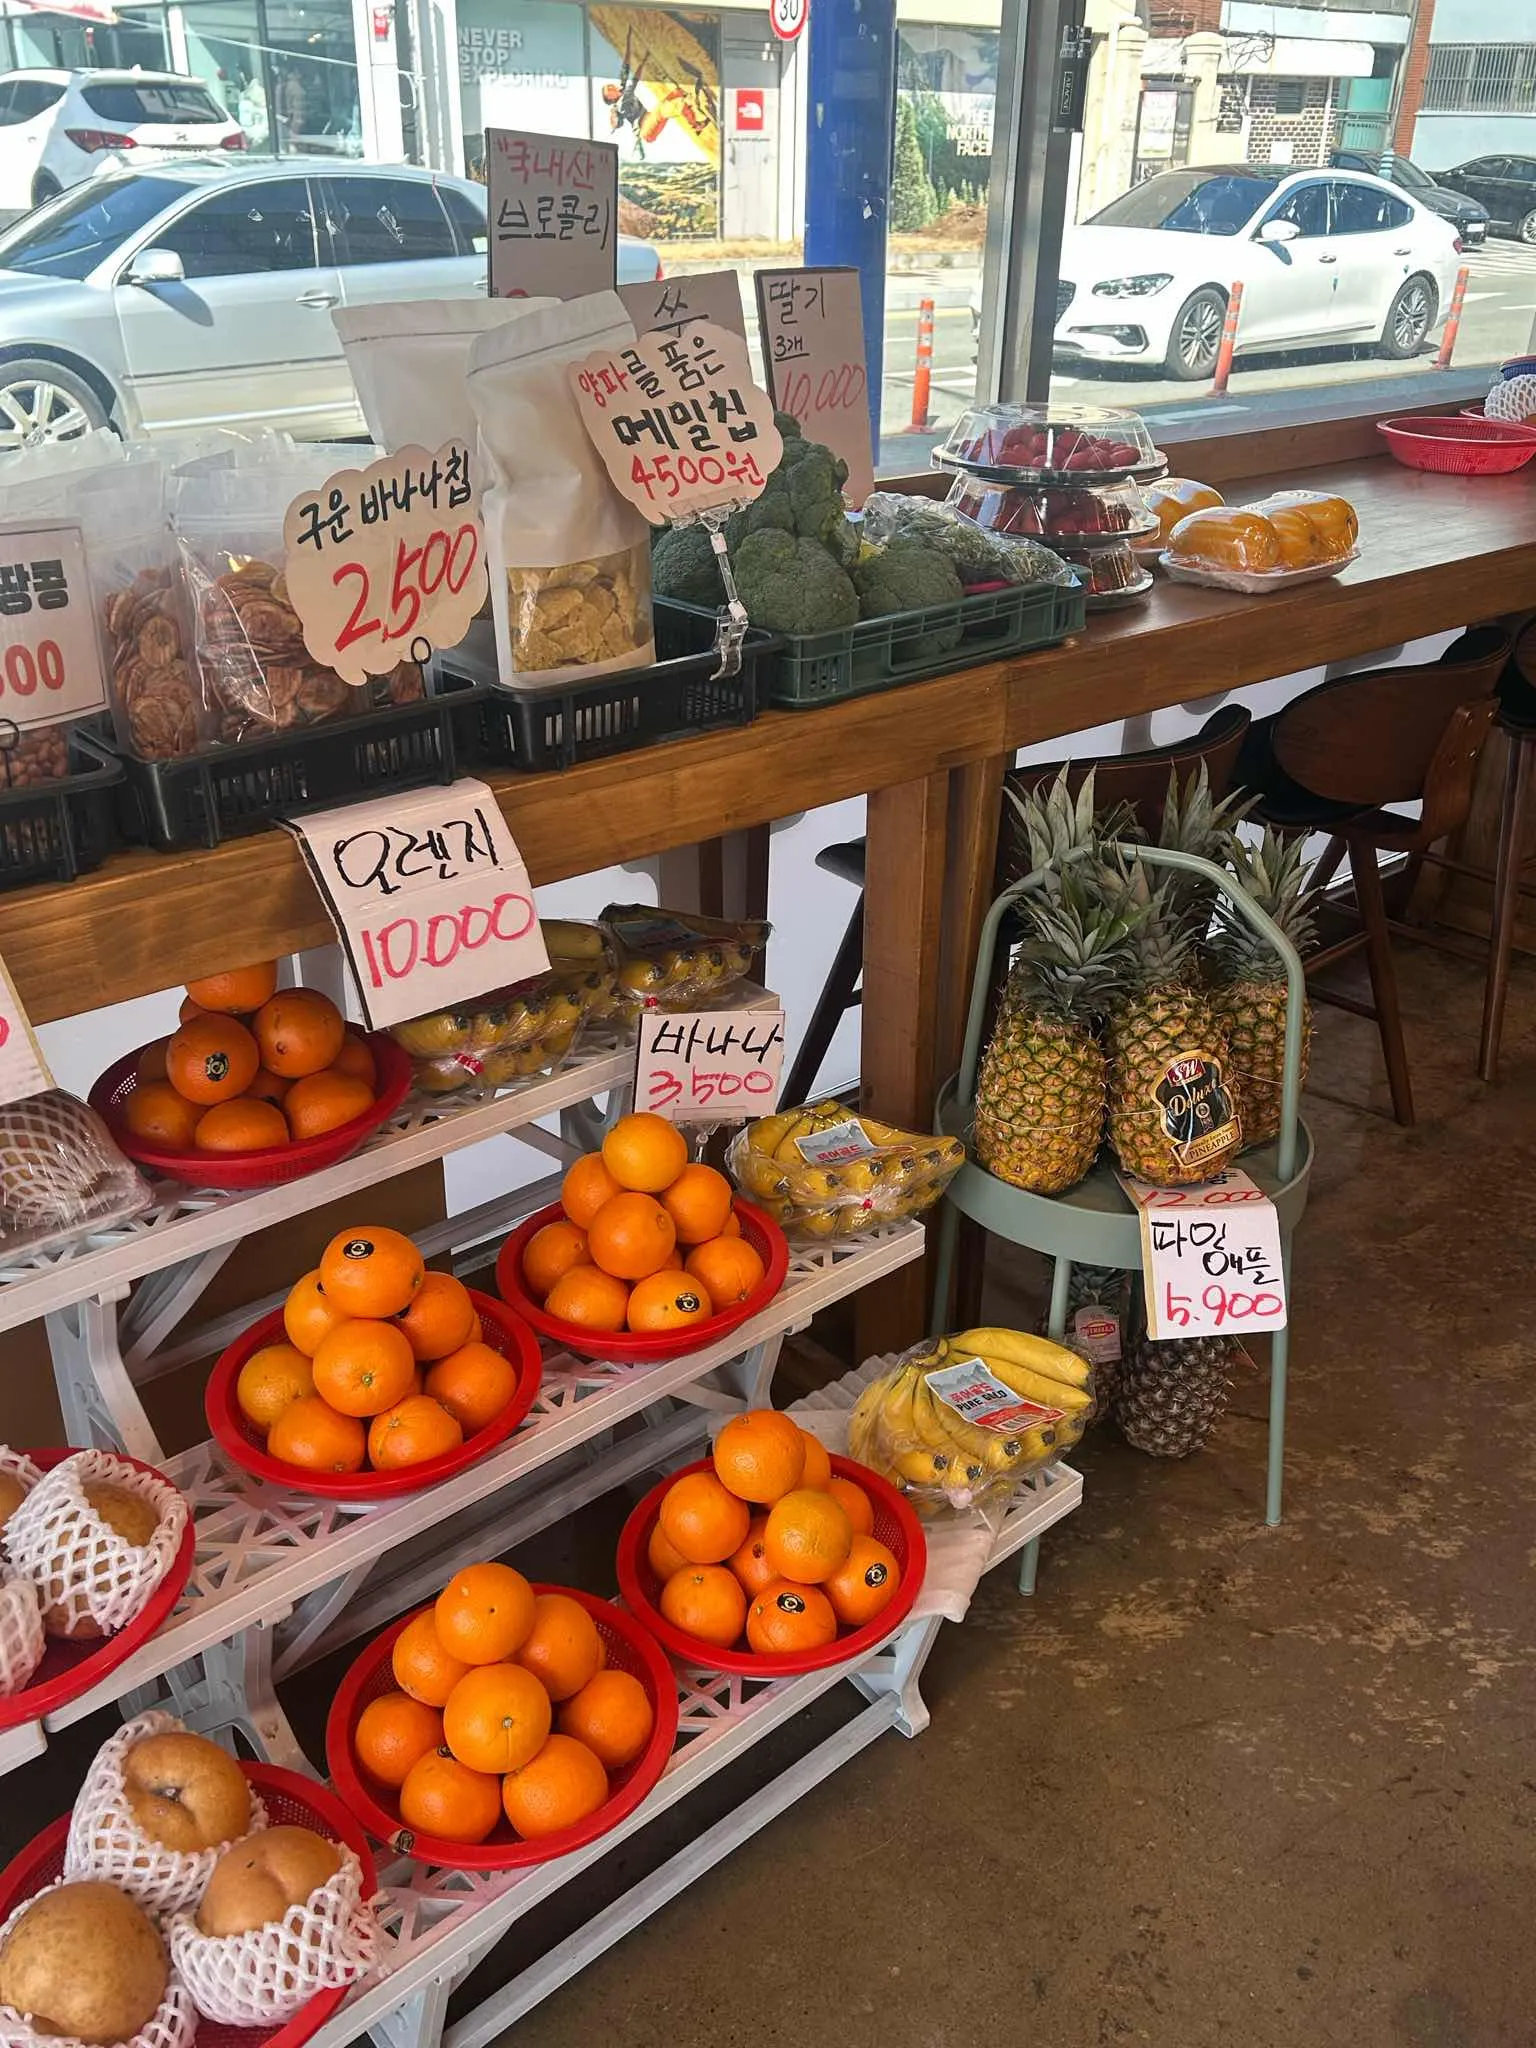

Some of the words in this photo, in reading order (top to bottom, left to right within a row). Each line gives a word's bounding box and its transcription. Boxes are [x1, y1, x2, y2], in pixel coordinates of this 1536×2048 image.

[779, 0, 799, 21] 30
[459, 26, 523, 48] NEVER
[460, 46, 509, 66] STOP
[956, 140, 993, 156] FACE
[497, 194, 611, 251] 브로콜리
[769, 276, 826, 325] 딸기
[773, 333, 804, 358] 3개
[578, 349, 666, 408] 양파를
[656, 335, 726, 392] 품은
[611, 388, 758, 452] 메밀칩
[297, 487, 356, 551] 구운
[359, 445, 472, 526] 바나나칩
[630, 450, 766, 500] 4500원
[0, 638, 65, 697] 00
[333, 808, 499, 895] 오렌지
[650, 1018, 784, 1065] 바나나
[1189, 1130, 1235, 1160] PINEAPPLE
[1202, 1246, 1281, 1286] 애플
[955, 1398, 985, 1413] PURE
[981, 1389, 1008, 1402] GOLD
